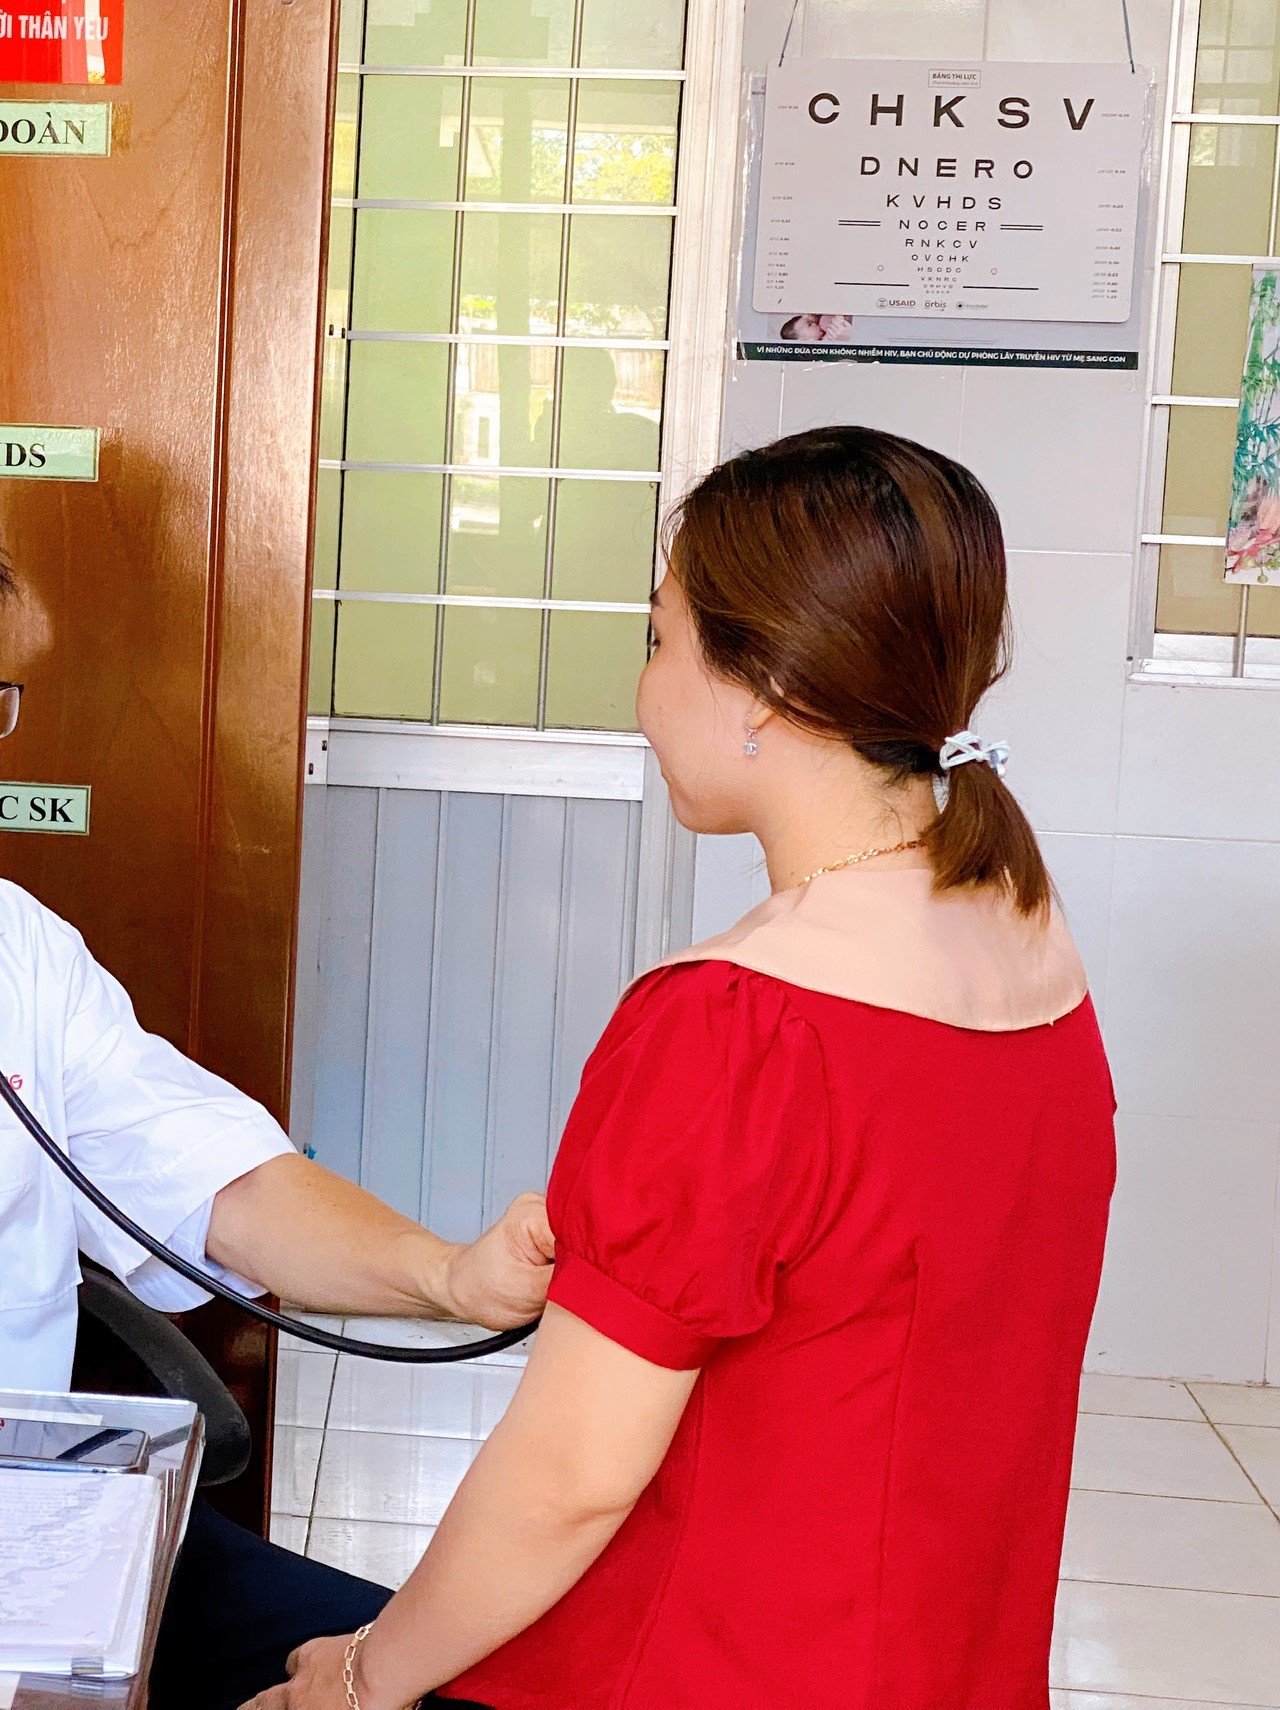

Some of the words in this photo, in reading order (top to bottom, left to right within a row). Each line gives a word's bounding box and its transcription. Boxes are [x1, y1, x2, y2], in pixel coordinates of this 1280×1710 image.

[19, 11, 67, 40] THÂN
[1109, 355, 1126, 363] CON
[29, 797, 74, 823] SK
